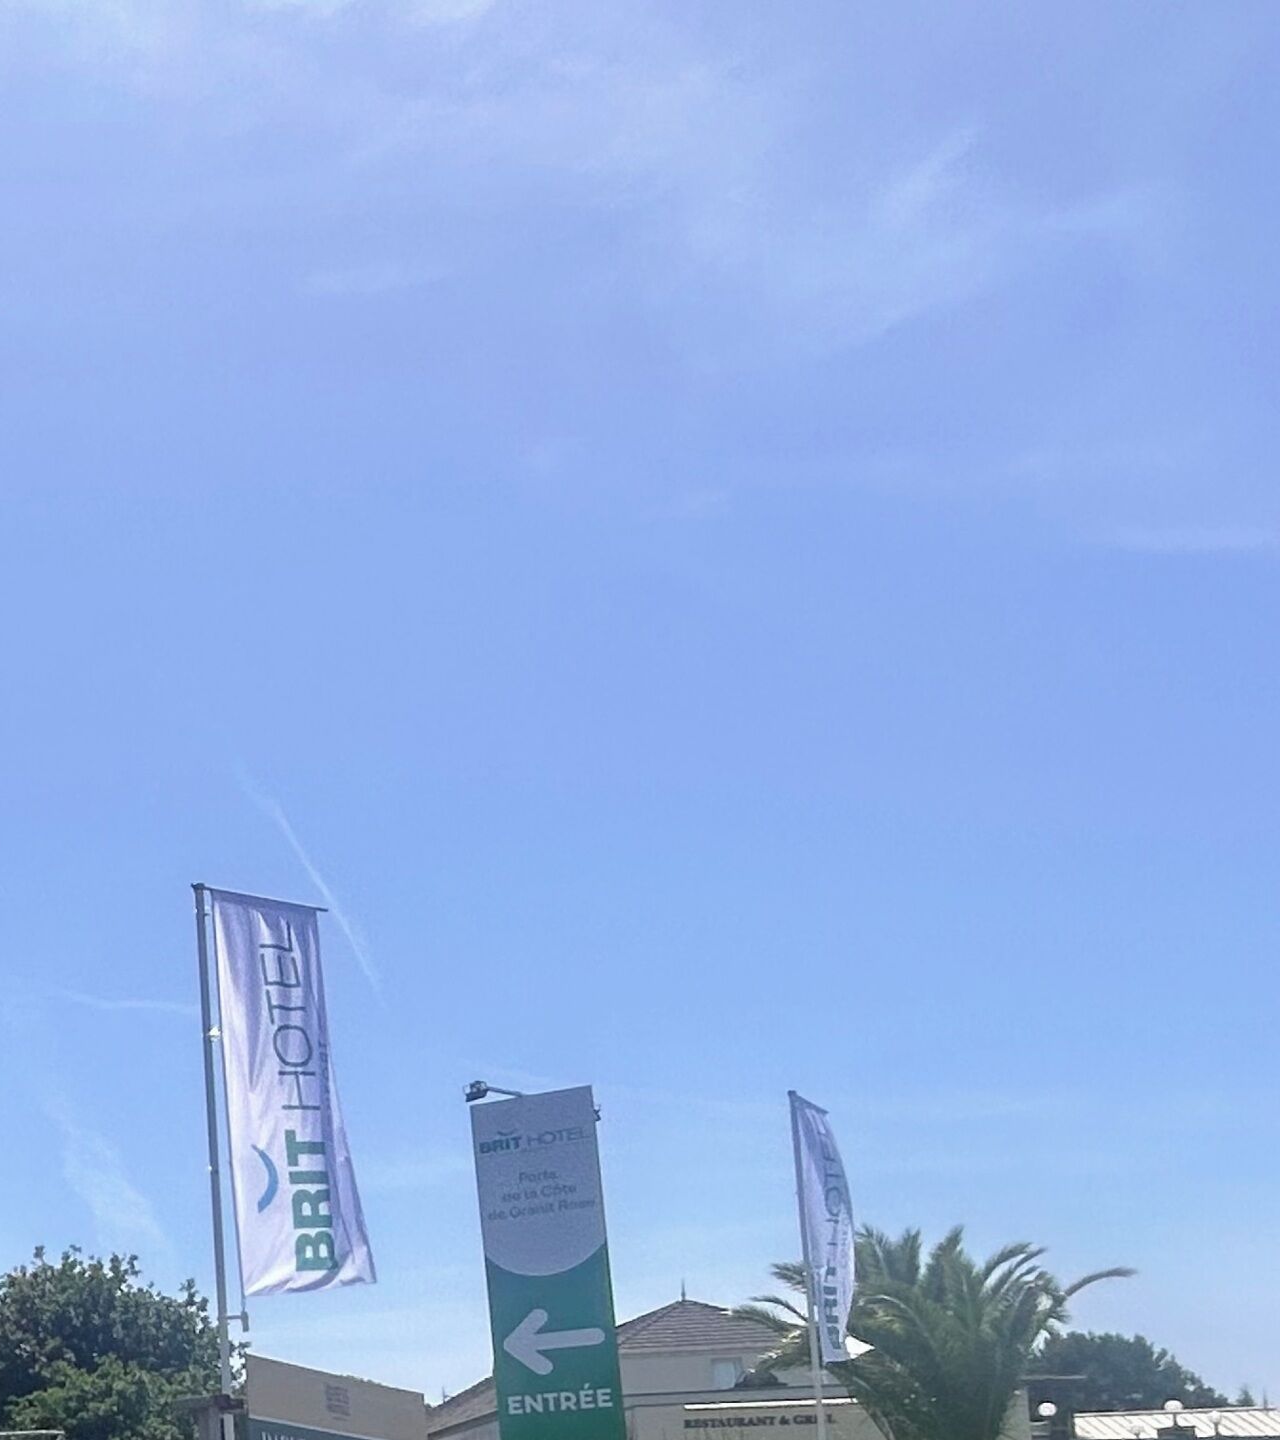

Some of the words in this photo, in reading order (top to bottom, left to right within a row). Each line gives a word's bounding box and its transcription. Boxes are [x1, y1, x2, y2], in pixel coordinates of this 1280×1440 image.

[260, 921, 321, 1110] HOTEL
[480, 1136, 522, 1153] BRIT
[527, 1127, 591, 1146] HOTEL
[284, 1129, 336, 1272] BRIT
[507, 1383, 614, 1415] ENTRÉE
[684, 1416, 777, 1429] RESTAURANT
[793, 1413, 836, 1425] GRIL
